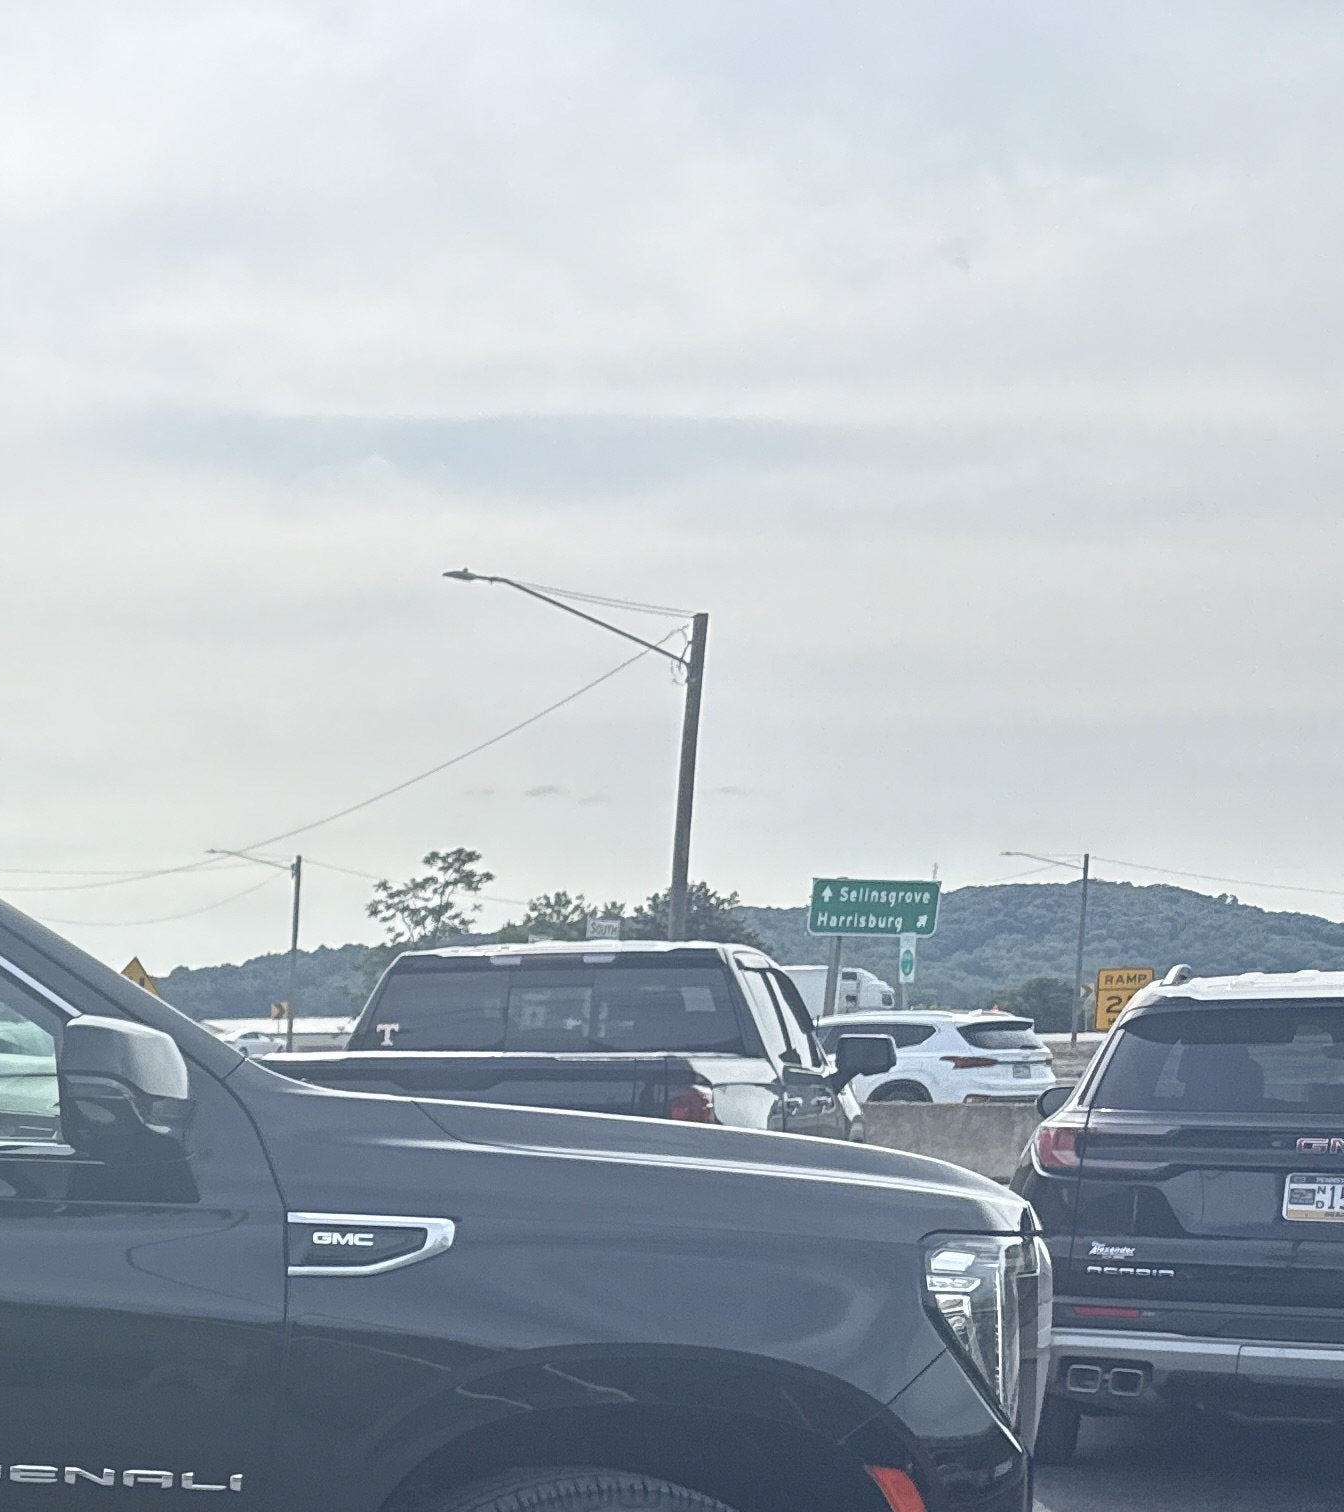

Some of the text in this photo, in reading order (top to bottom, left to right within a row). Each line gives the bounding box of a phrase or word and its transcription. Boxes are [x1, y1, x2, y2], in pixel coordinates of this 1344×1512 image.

[839, 886, 931, 908] Selinsgrove
[816, 911, 903, 932] Harrisburg
[1104, 973, 1148, 985] RAMP
[1105, 995, 1133, 1013] 2
[312, 1231, 375, 1246] GMC
